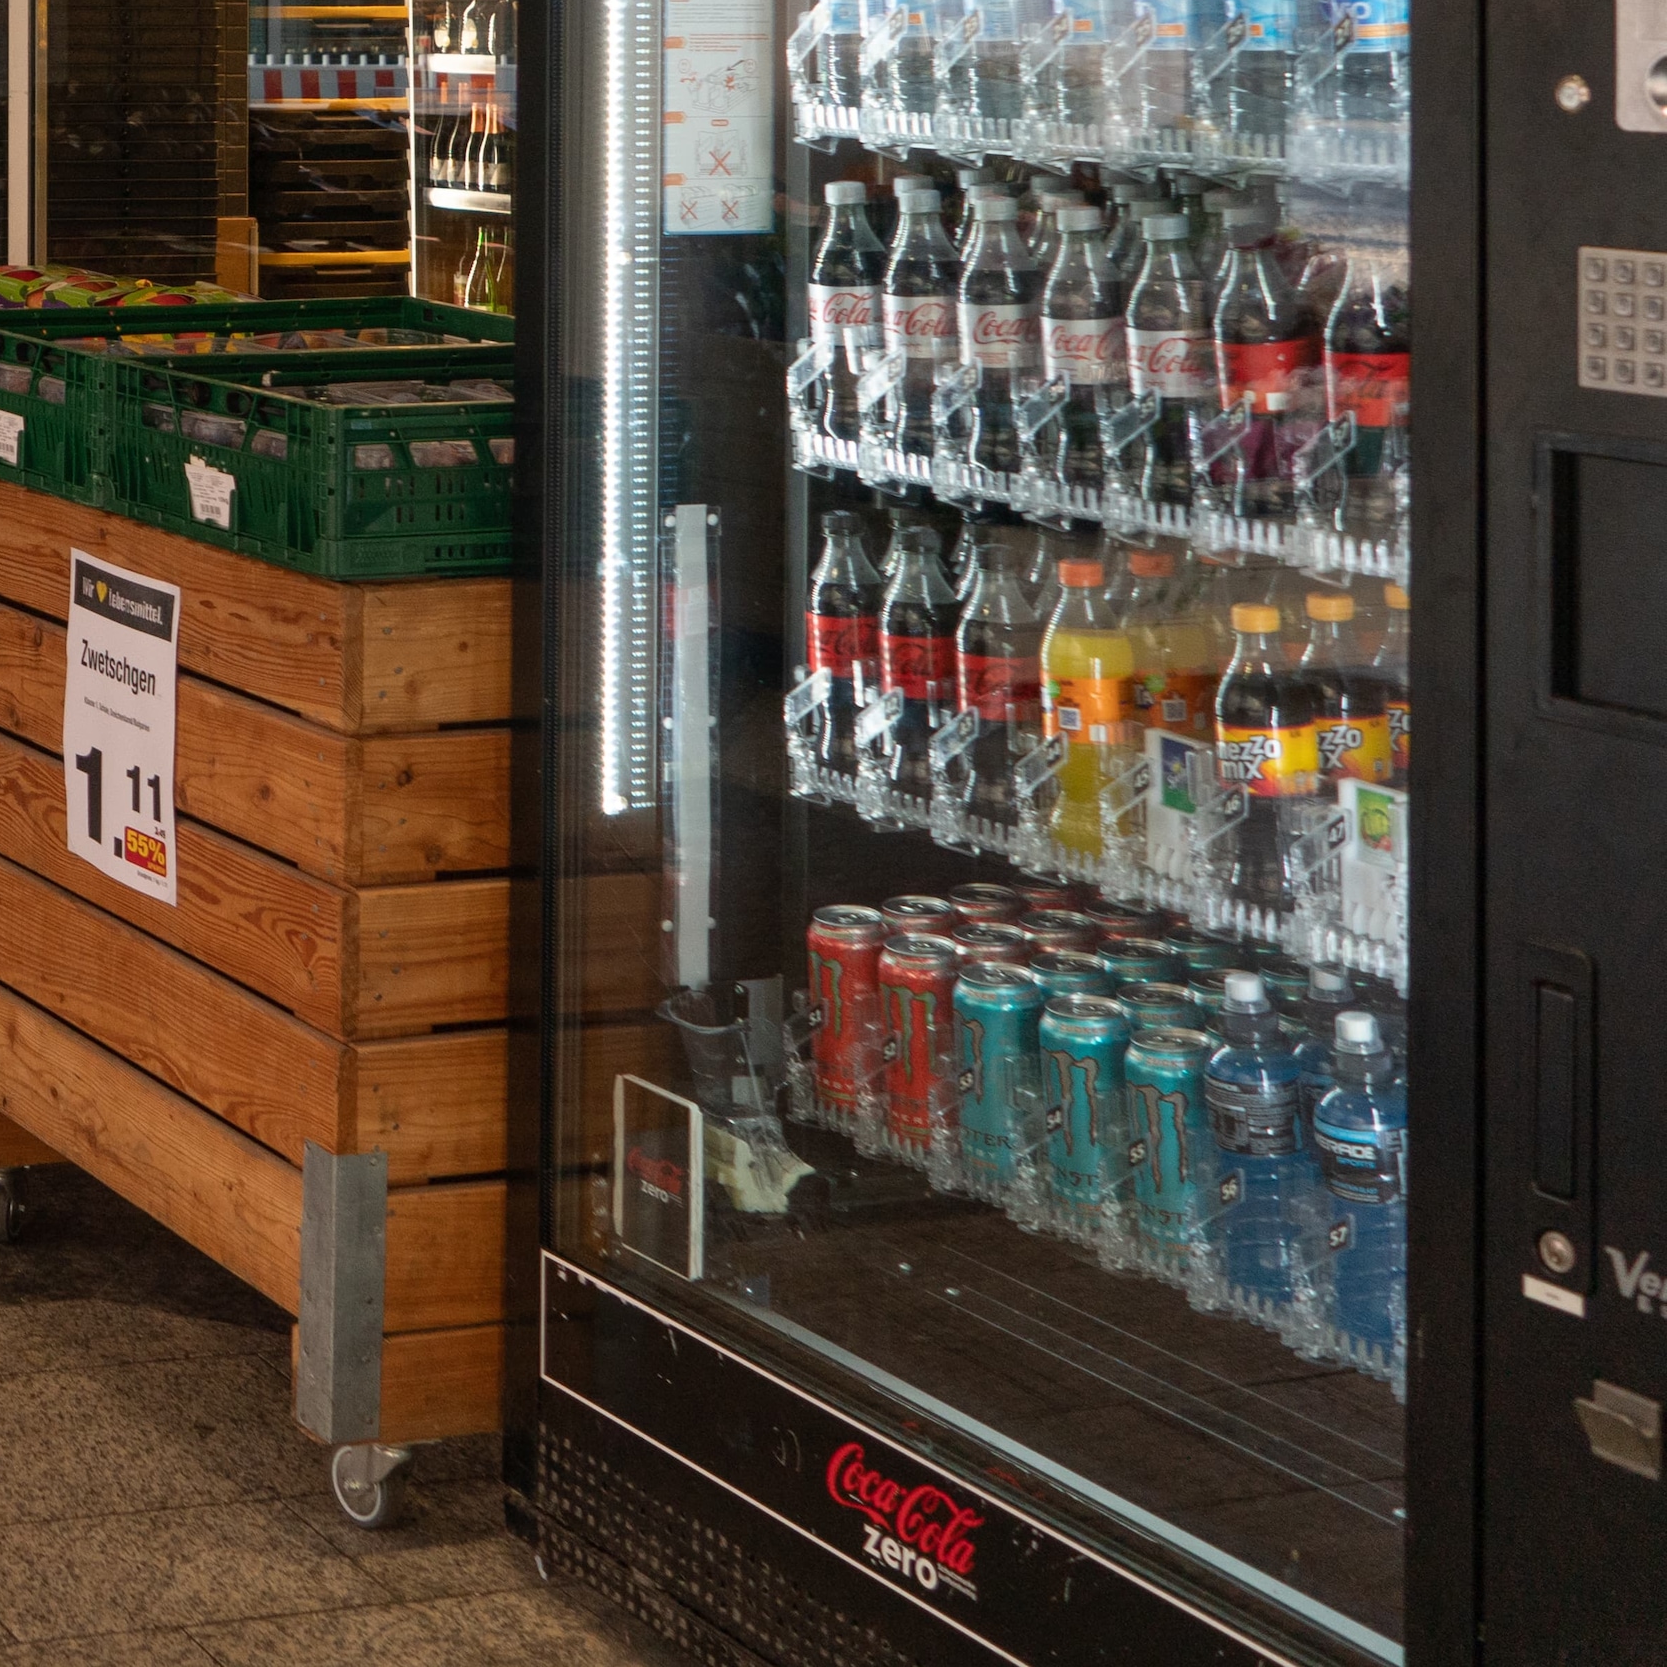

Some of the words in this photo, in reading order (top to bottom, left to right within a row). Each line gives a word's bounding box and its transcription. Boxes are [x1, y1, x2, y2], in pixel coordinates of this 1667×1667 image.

[82, 575, 95, 598] Wir
[108, 587, 163, 625] Lebensmittel.
[80, 638, 156, 696] Zwetschgen
[126, 764, 162, 823] 11
[1220, 755, 1264, 781] mix
[126, 828, 165, 866] 55%
[826, 1441, 985, 1575] Coca-Cola
[862, 1522, 939, 1591] zero
